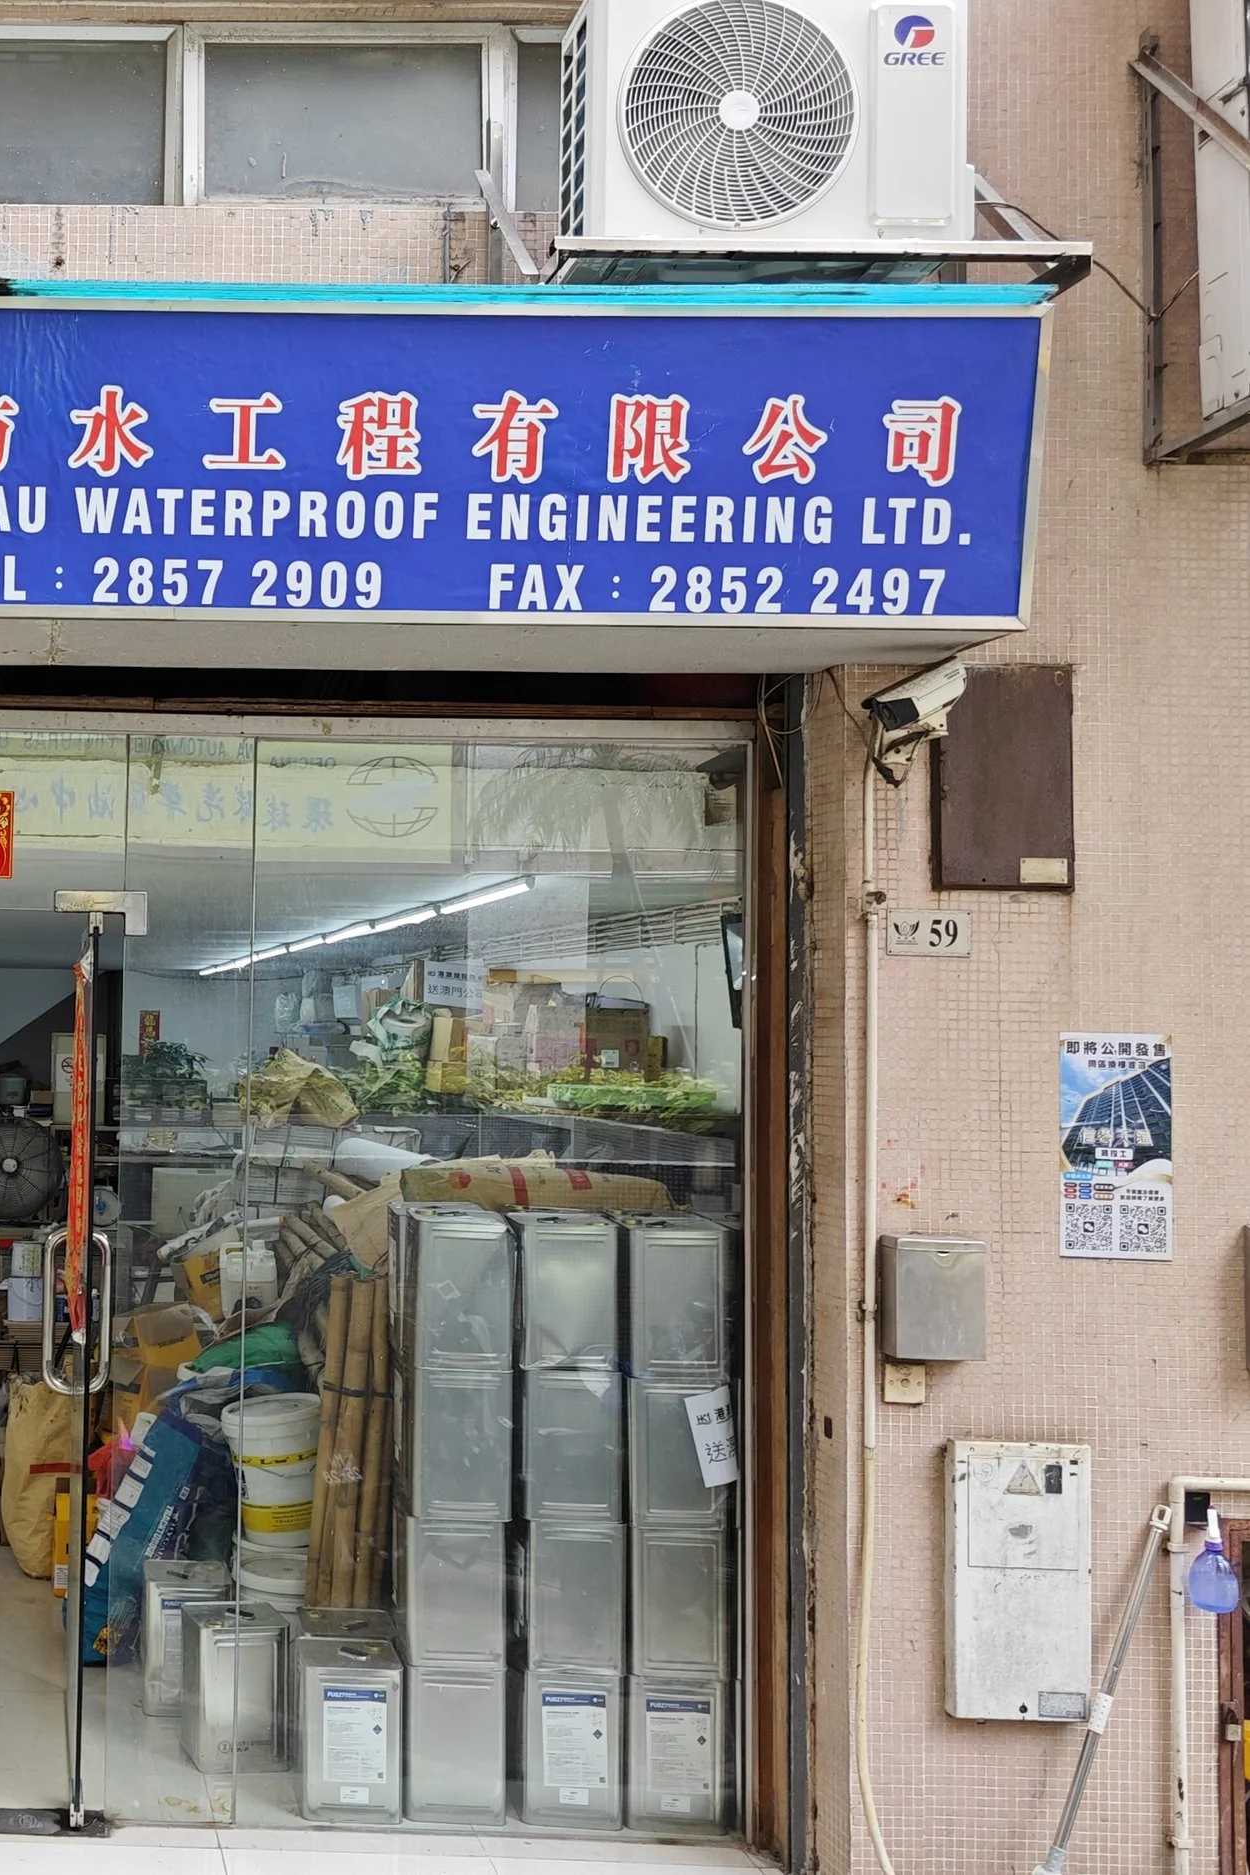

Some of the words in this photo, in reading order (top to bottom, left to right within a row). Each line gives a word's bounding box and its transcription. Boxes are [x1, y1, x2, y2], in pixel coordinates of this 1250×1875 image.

[883, 52, 946, 66] GREE
[75, 487, 439, 541] WATERPROOF
[466, 492, 833, 545] ENGINEERING
[861, 497, 972, 546] LTD.
[92, 556, 223, 606] 2857
[251, 560, 383, 610] 2909
[649, 565, 783, 614] 2852
[810, 567, 946, 615] 2497
[929, 919, 958, 947] 59
[1066, 1041, 1166, 1057] 即將公開發售
